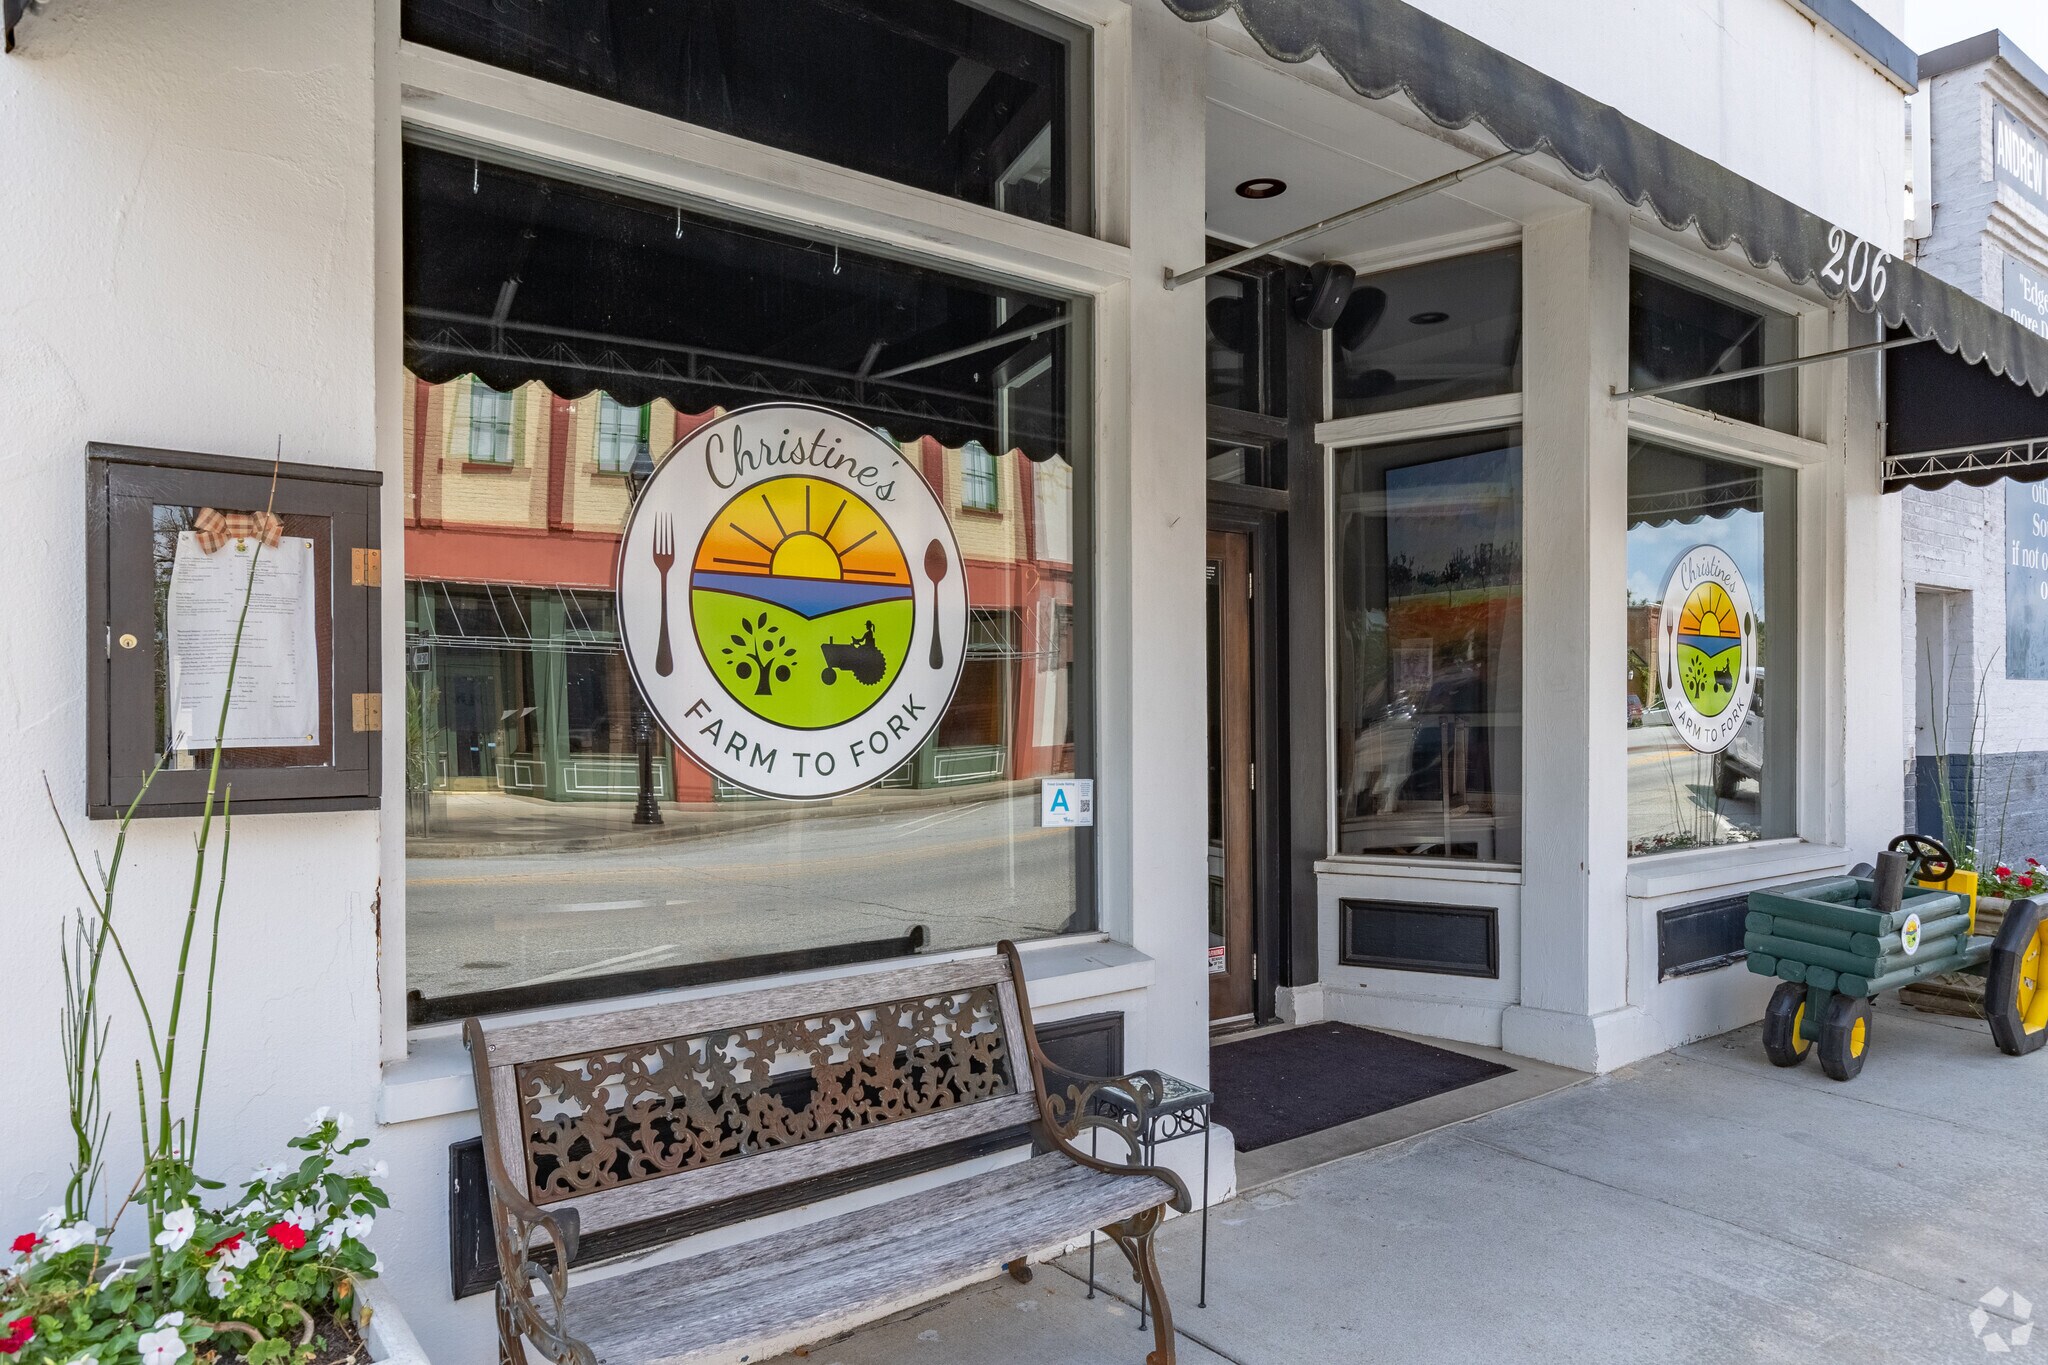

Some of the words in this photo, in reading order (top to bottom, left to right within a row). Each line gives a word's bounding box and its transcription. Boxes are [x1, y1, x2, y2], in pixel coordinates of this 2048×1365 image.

[1996, 120, 2043, 196] ANDREW
[1821, 225, 1892, 302] 206
[705, 424, 900, 502] Christine's
[2033, 512, 2048, 538] So
[1681, 555, 1737, 593] Christine's
[2012, 539, 2020, 566] if
[2022, 546, 2039, 569] not
[684, 698, 777, 774] FARM
[792, 752, 836, 778] TO
[850, 693, 926, 767] FORK
[1674, 701, 1701, 739] FARM
[1705, 728, 1718, 743] TO
[1721, 697, 1745, 737] FORK
[1050, 788, 1070, 812] A
